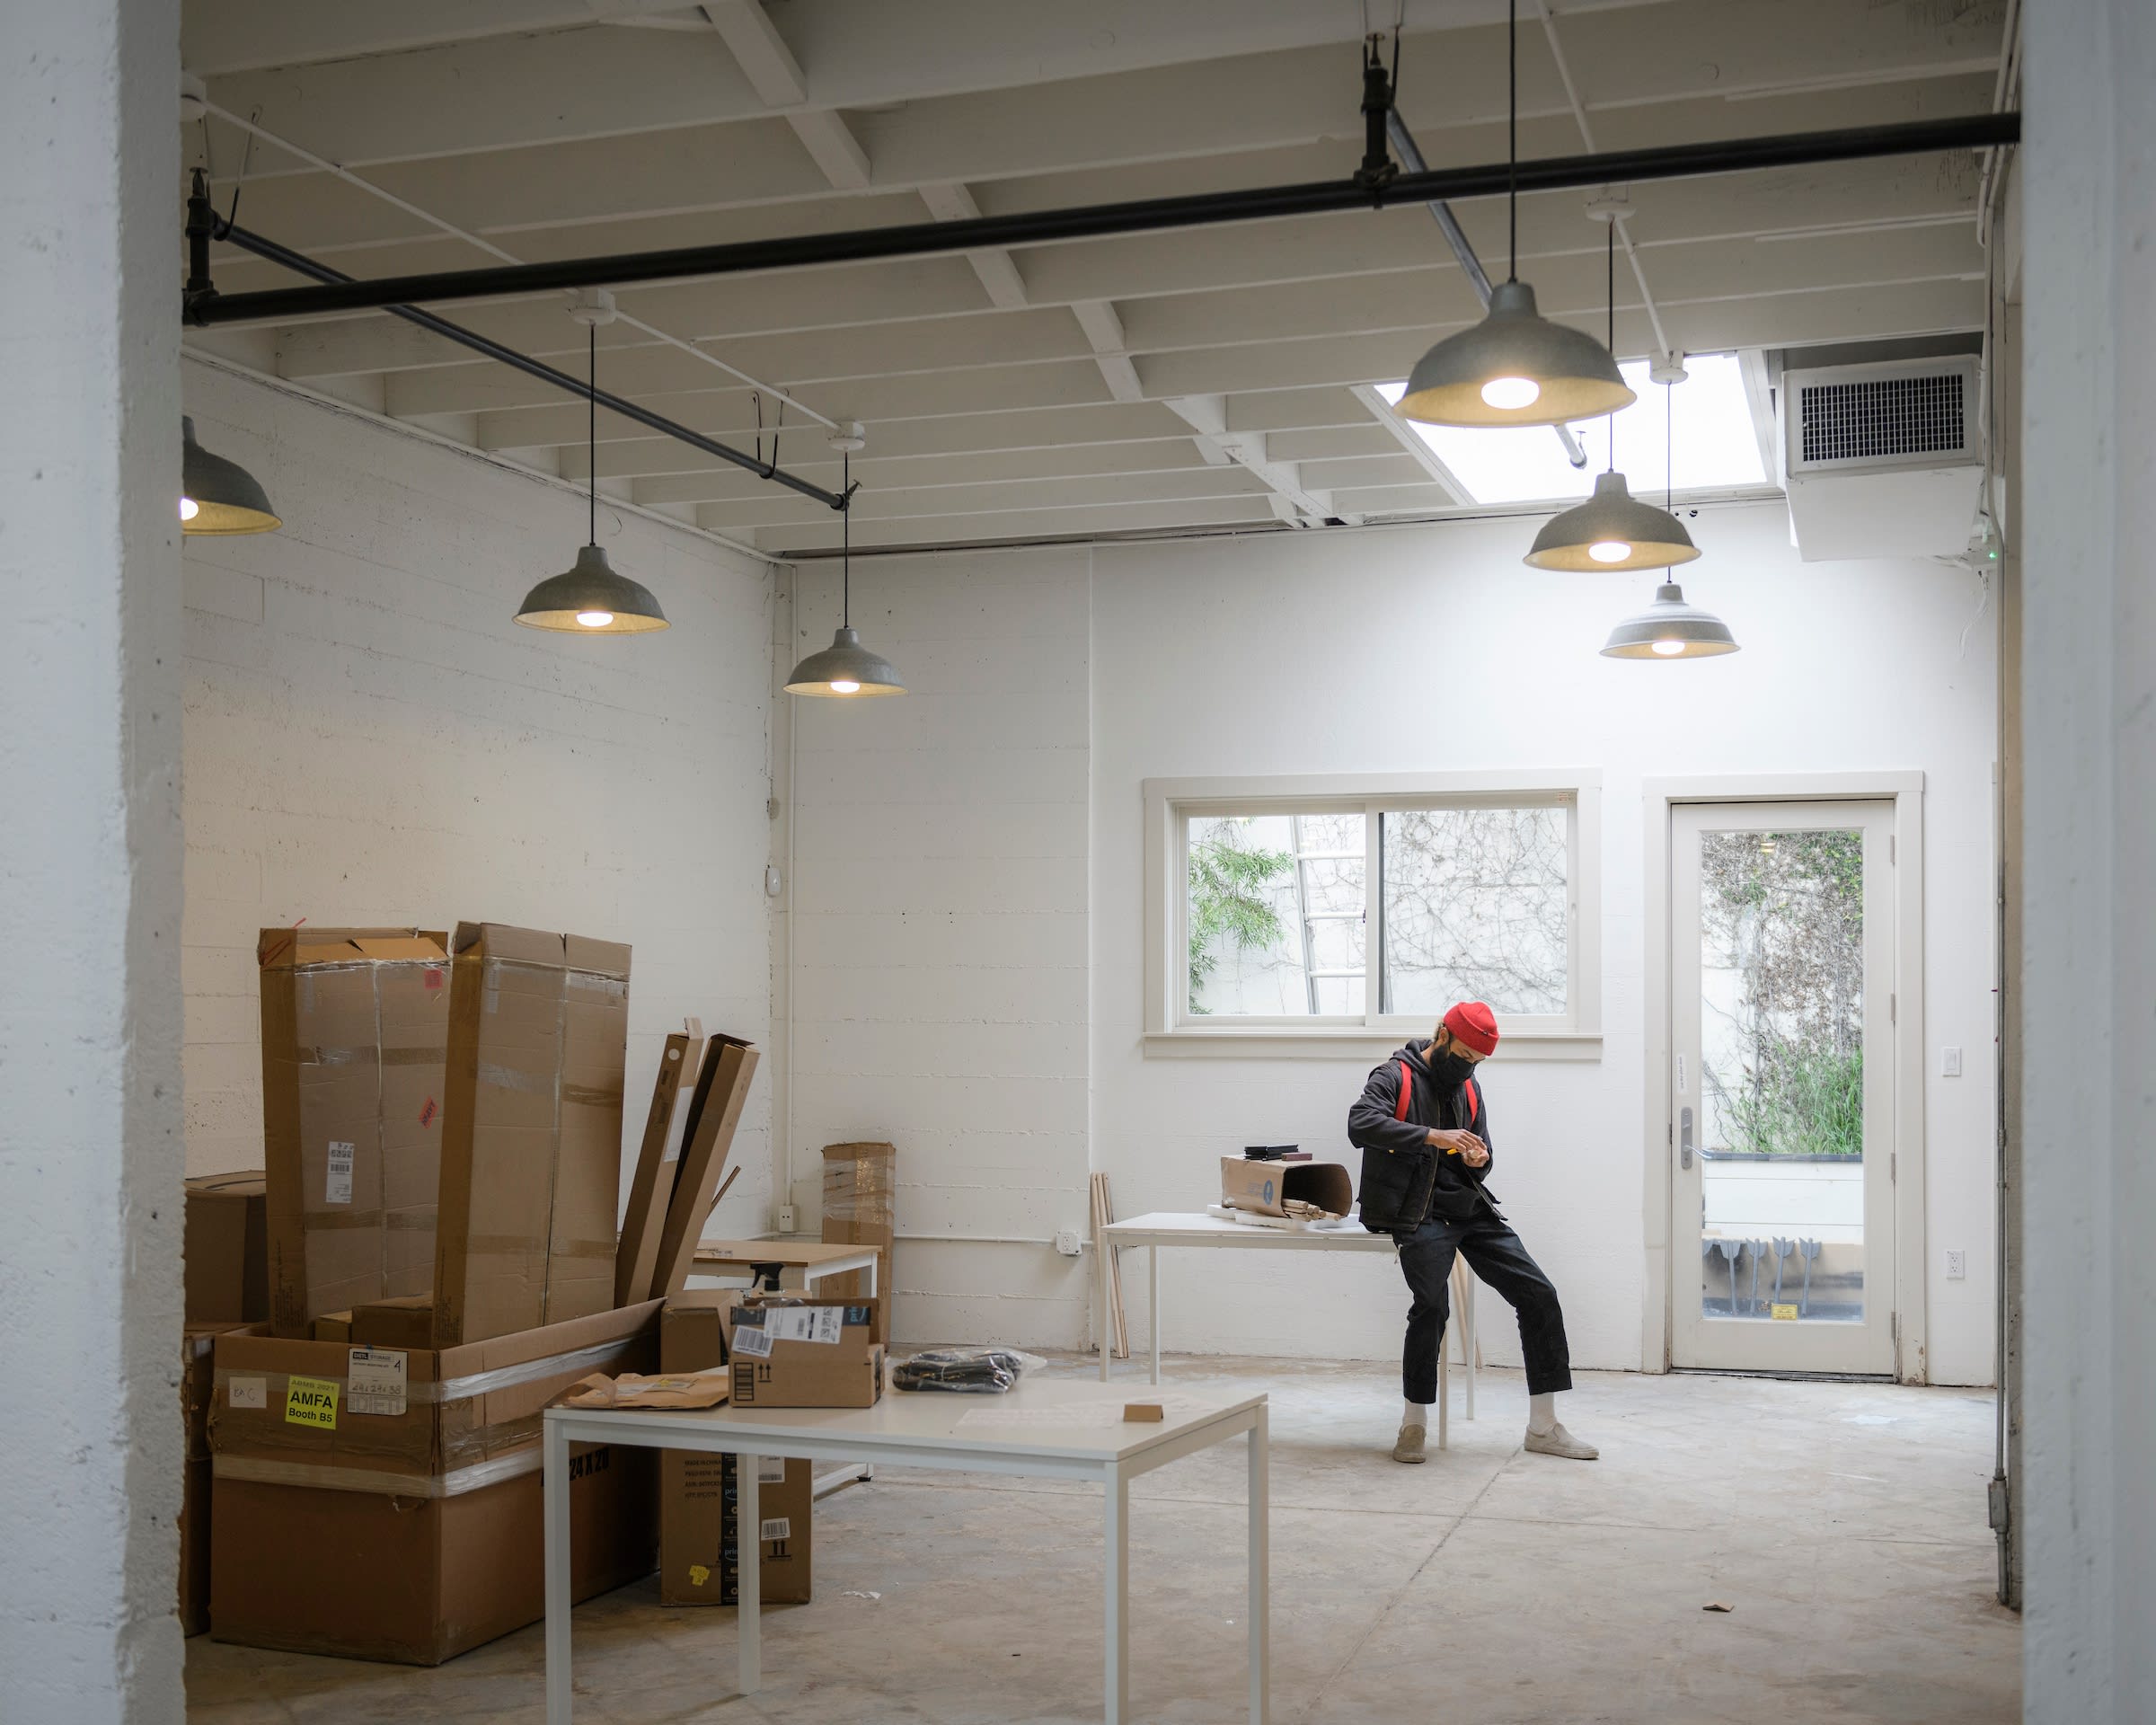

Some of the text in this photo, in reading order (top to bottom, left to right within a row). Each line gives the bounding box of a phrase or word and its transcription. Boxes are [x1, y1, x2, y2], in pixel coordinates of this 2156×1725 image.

[290, 1391, 332, 1409] AMFA
[288, 1407, 332, 1422] Booth B5
